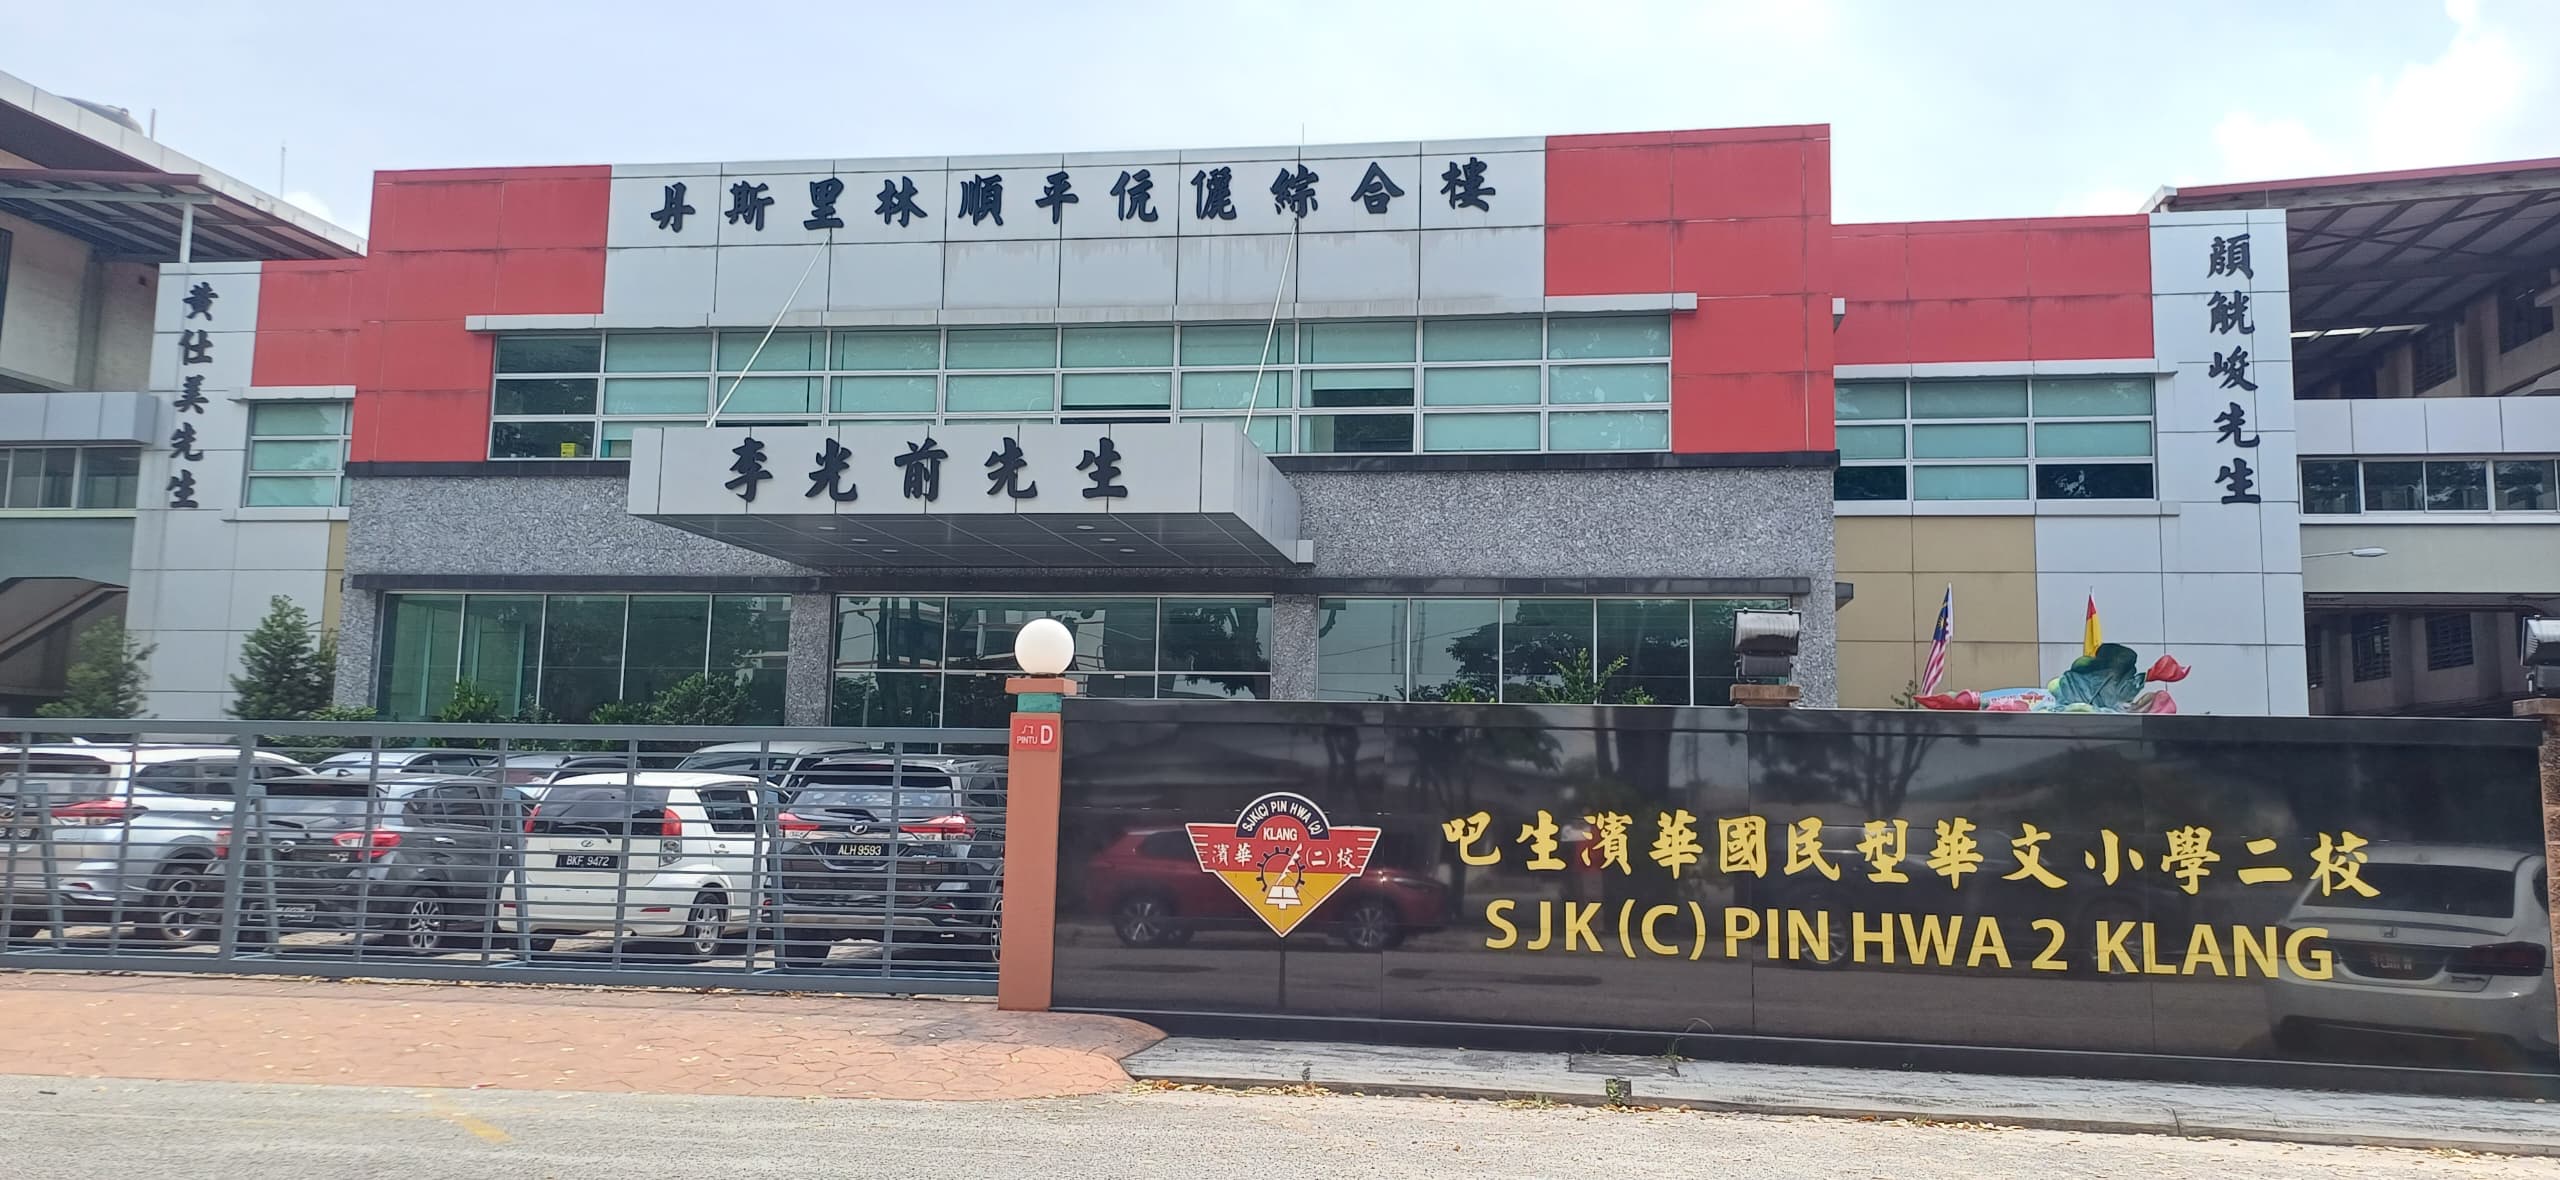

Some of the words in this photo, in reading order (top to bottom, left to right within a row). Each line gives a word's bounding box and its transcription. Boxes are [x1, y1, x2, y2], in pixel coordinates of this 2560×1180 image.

[725, 437, 1128, 501] 李光前先生
[1016, 735, 1038, 745] PINTU
[1040, 724, 1054, 745] D
[1242, 803, 1269, 832] SJK(C)
[1270, 800, 1287, 814] PIN
[1289, 802, 1312, 824] HWA
[1308, 820, 1324, 836] (2)
[1263, 826, 1298, 841] KLANG
[838, 844, 857, 856] ALH
[857, 844, 882, 856] 9593
[566, 855, 585, 866] BKF
[586, 856, 610, 867] 9472
[1724, 906, 1831, 963] PIN
[1851, 911, 2013, 970] HWA
[2030, 918, 2069, 971] 2
[2095, 920, 2335, 981] KLANG
